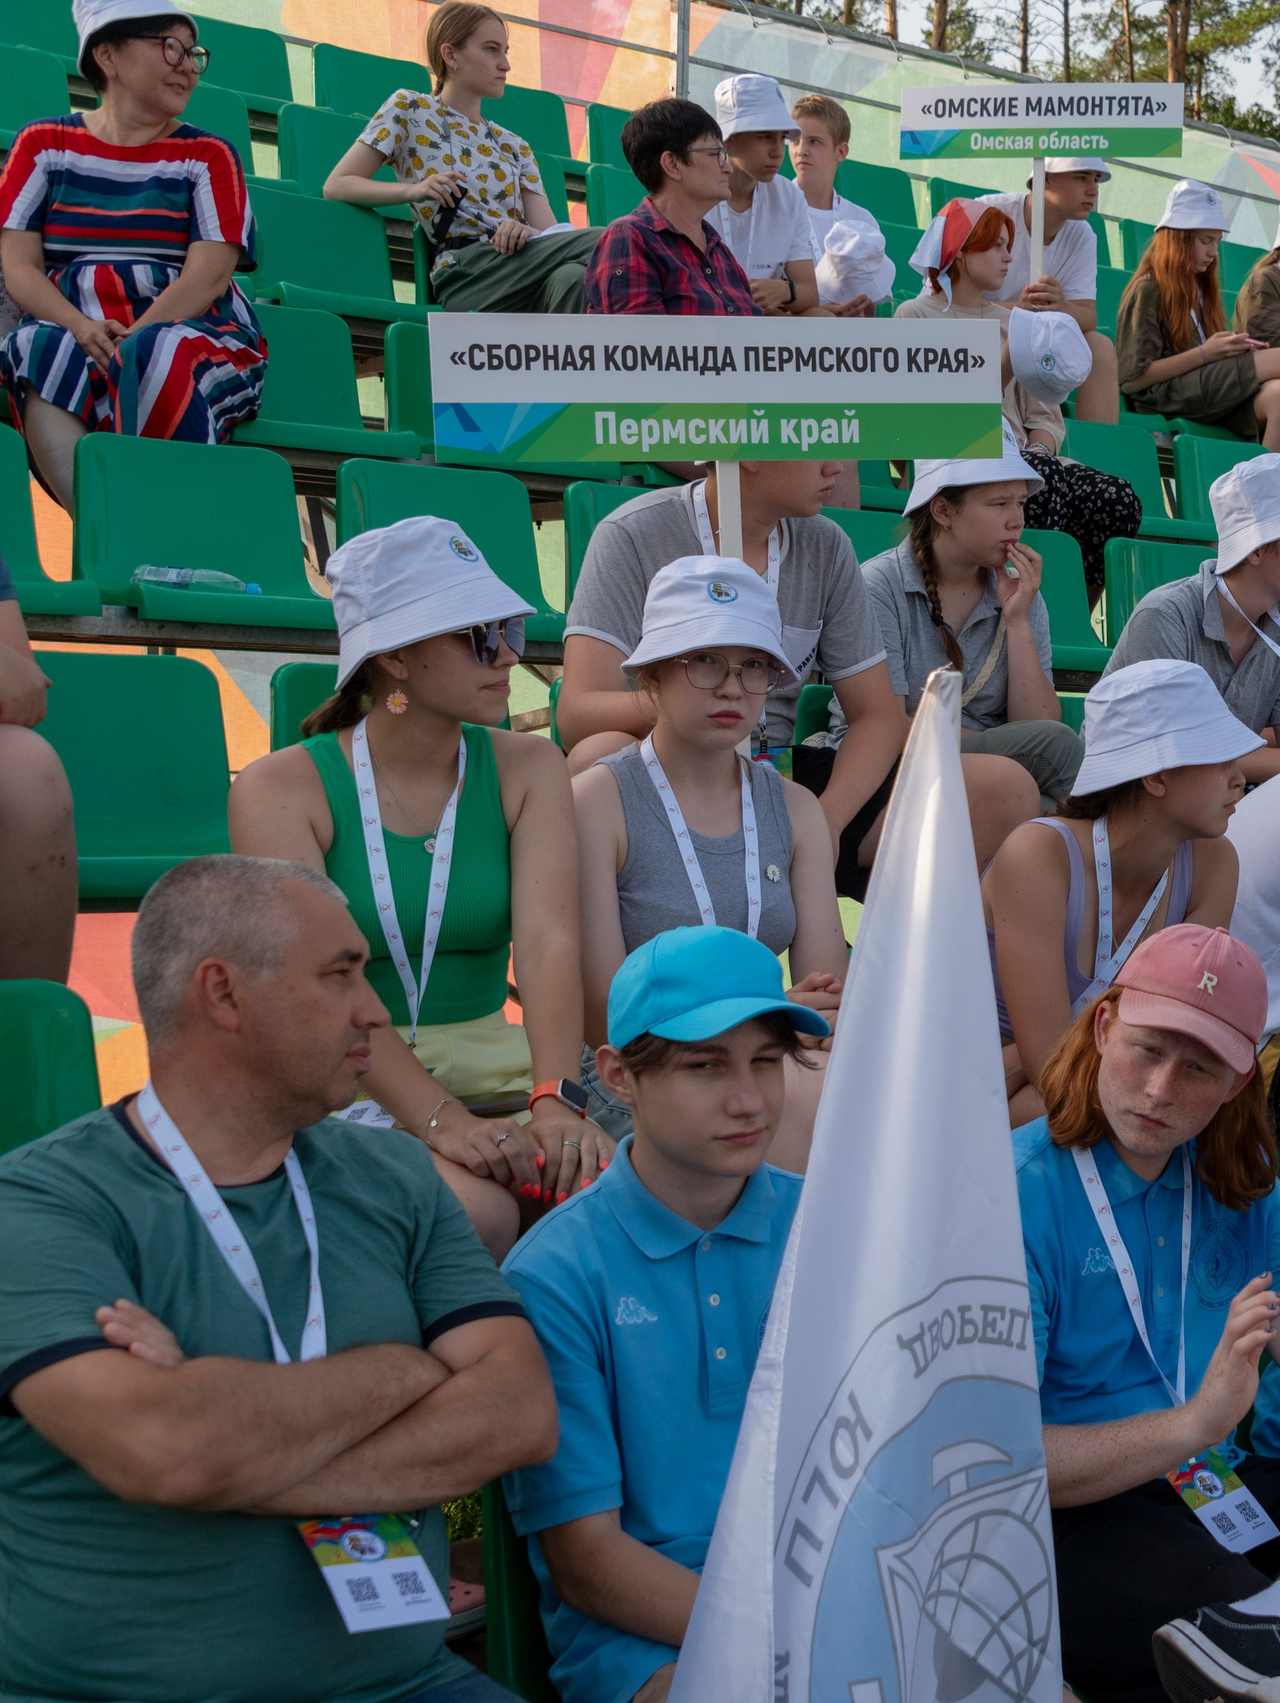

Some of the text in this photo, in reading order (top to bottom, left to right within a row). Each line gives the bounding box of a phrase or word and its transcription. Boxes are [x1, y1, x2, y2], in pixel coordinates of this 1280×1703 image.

[921, 95, 1168, 118] «ОМСКИЕ МАМОНТЯТА»
[970, 130, 1109, 150] Омская область
[450, 343, 986, 376] «СБОРНАЯ КОМАНДА ПЕРМСКОГО КРАЯ»
[594, 409, 860, 453] Пермский край
[1196, 970, 1219, 996] R
